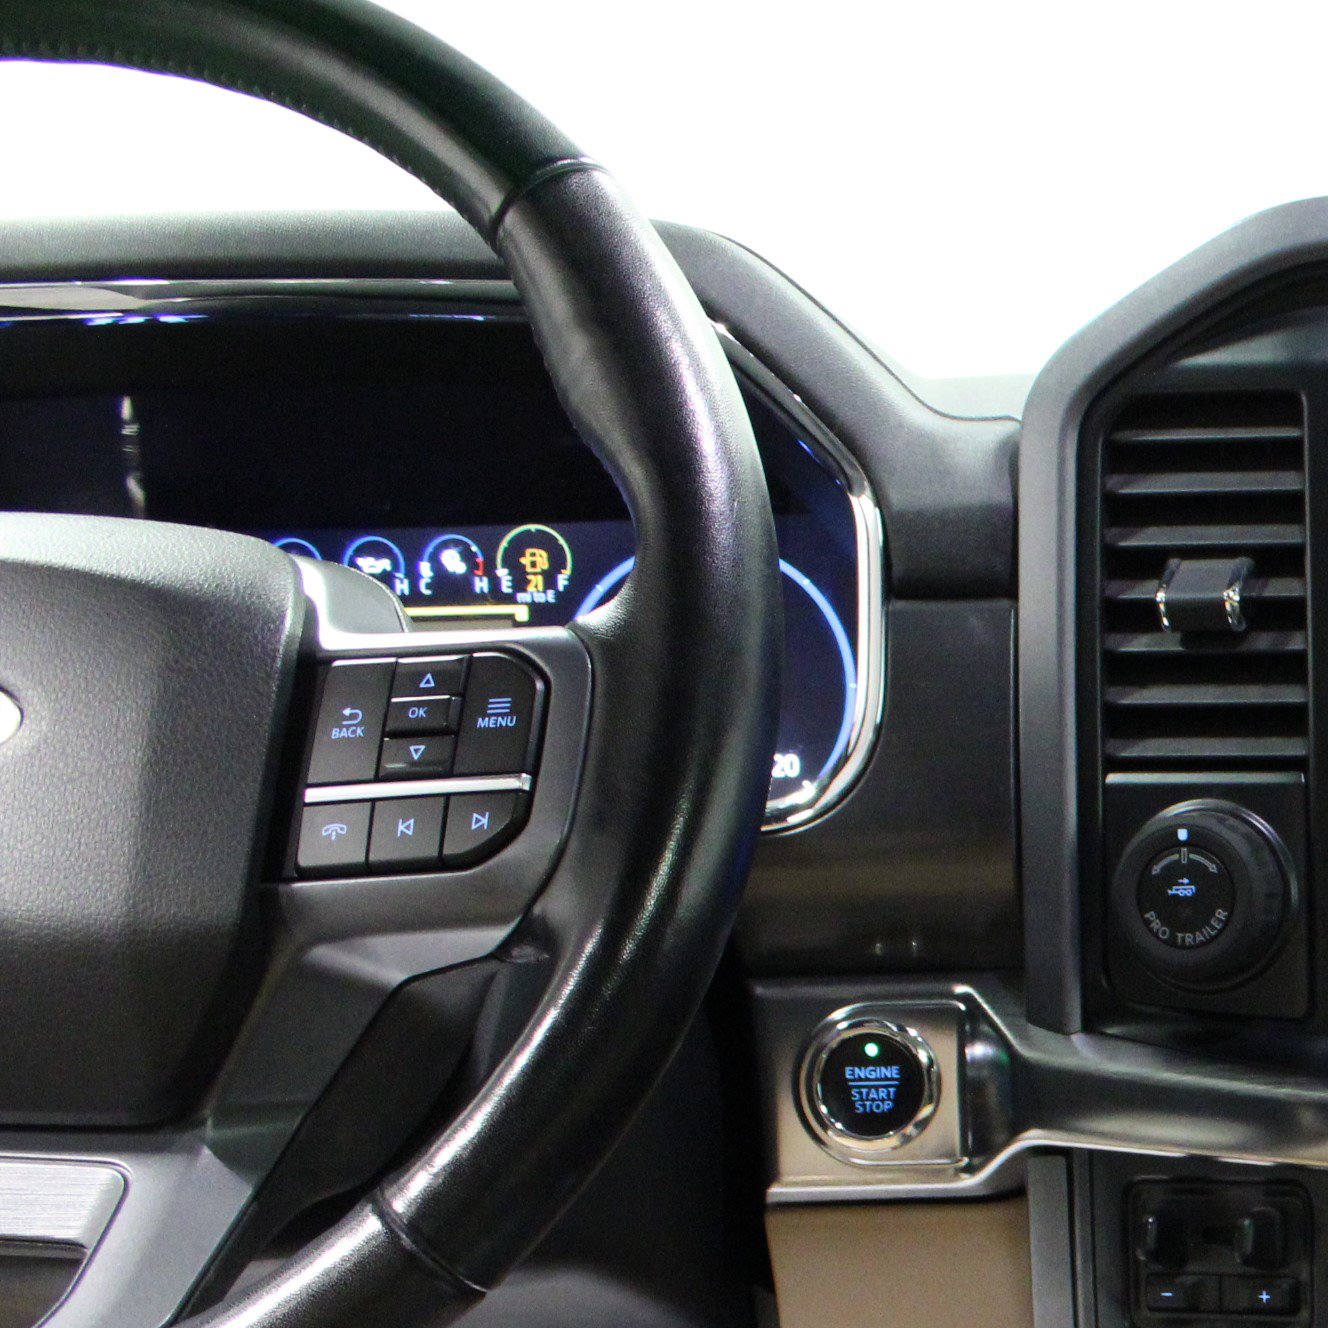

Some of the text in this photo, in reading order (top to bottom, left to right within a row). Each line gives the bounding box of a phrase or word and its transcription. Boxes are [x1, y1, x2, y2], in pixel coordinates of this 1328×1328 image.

[395, 579, 409, 595] H
[419, 579, 432, 595] C
[475, 578, 488, 593] H
[501, 576, 512, 593] E
[526, 575, 544, 591] 21
[557, 574, 569, 592] F
[547, 590, 556, 603] E
[409, 707, 427, 718] OK
[477, 716, 517, 728] MENU
[332, 727, 365, 739] BACK
[1144, 909, 1228, 945] PRO TRAILER
[845, 1066, 900, 1080] ENGINE
[851, 1087, 896, 1102] START
[854, 1099, 894, 1113] STOP
